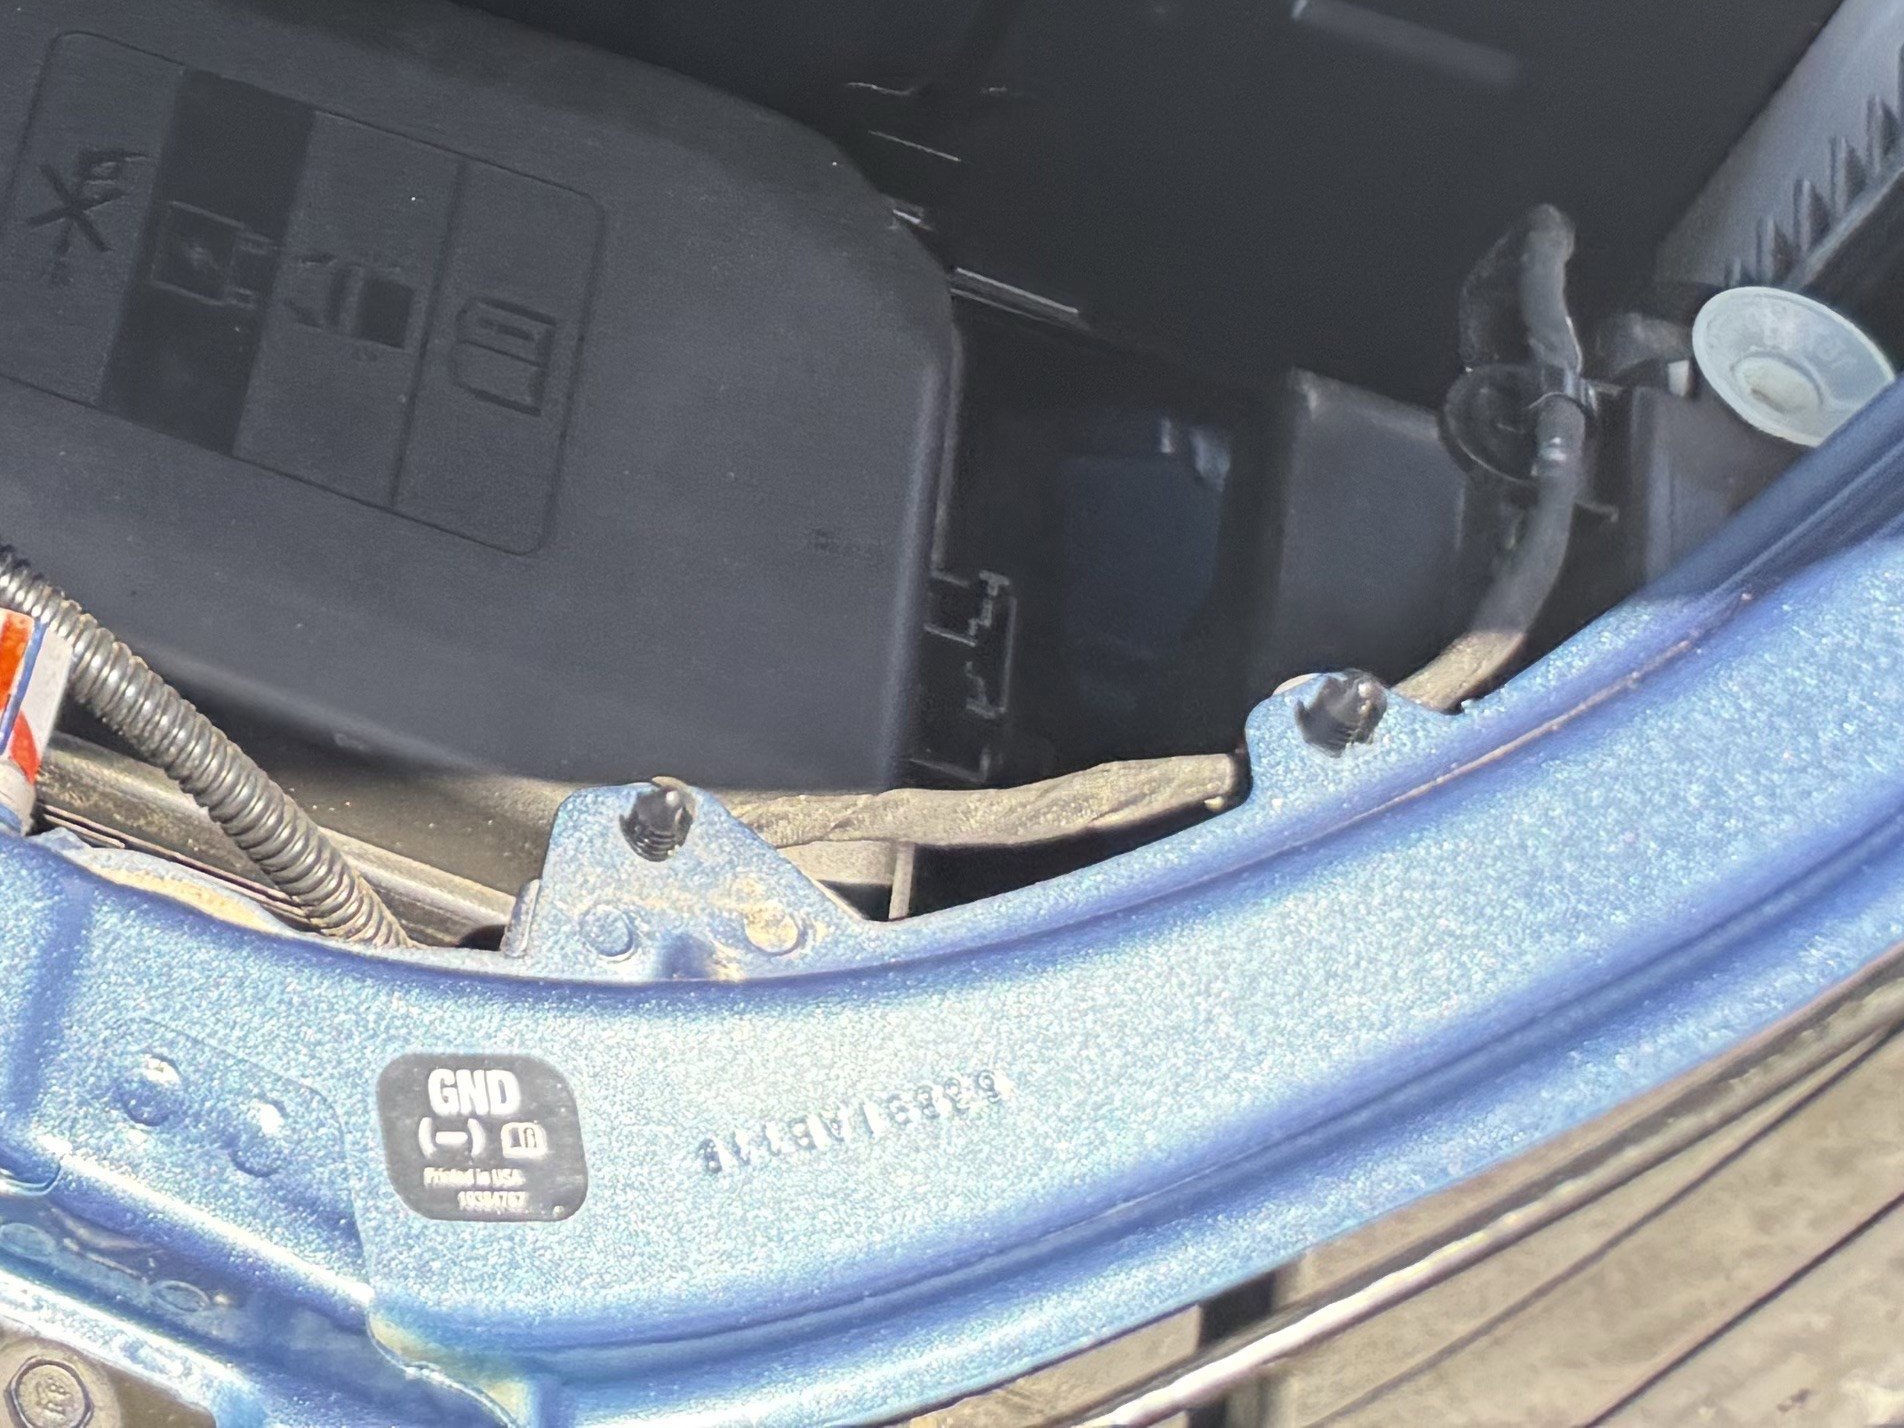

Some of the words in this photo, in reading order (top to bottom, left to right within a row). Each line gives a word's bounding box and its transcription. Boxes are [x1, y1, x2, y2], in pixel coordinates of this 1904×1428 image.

[428, 1067, 520, 1117] GND
[422, 1166, 474, 1186] Printed
[491, 1167, 525, 1187] USA
